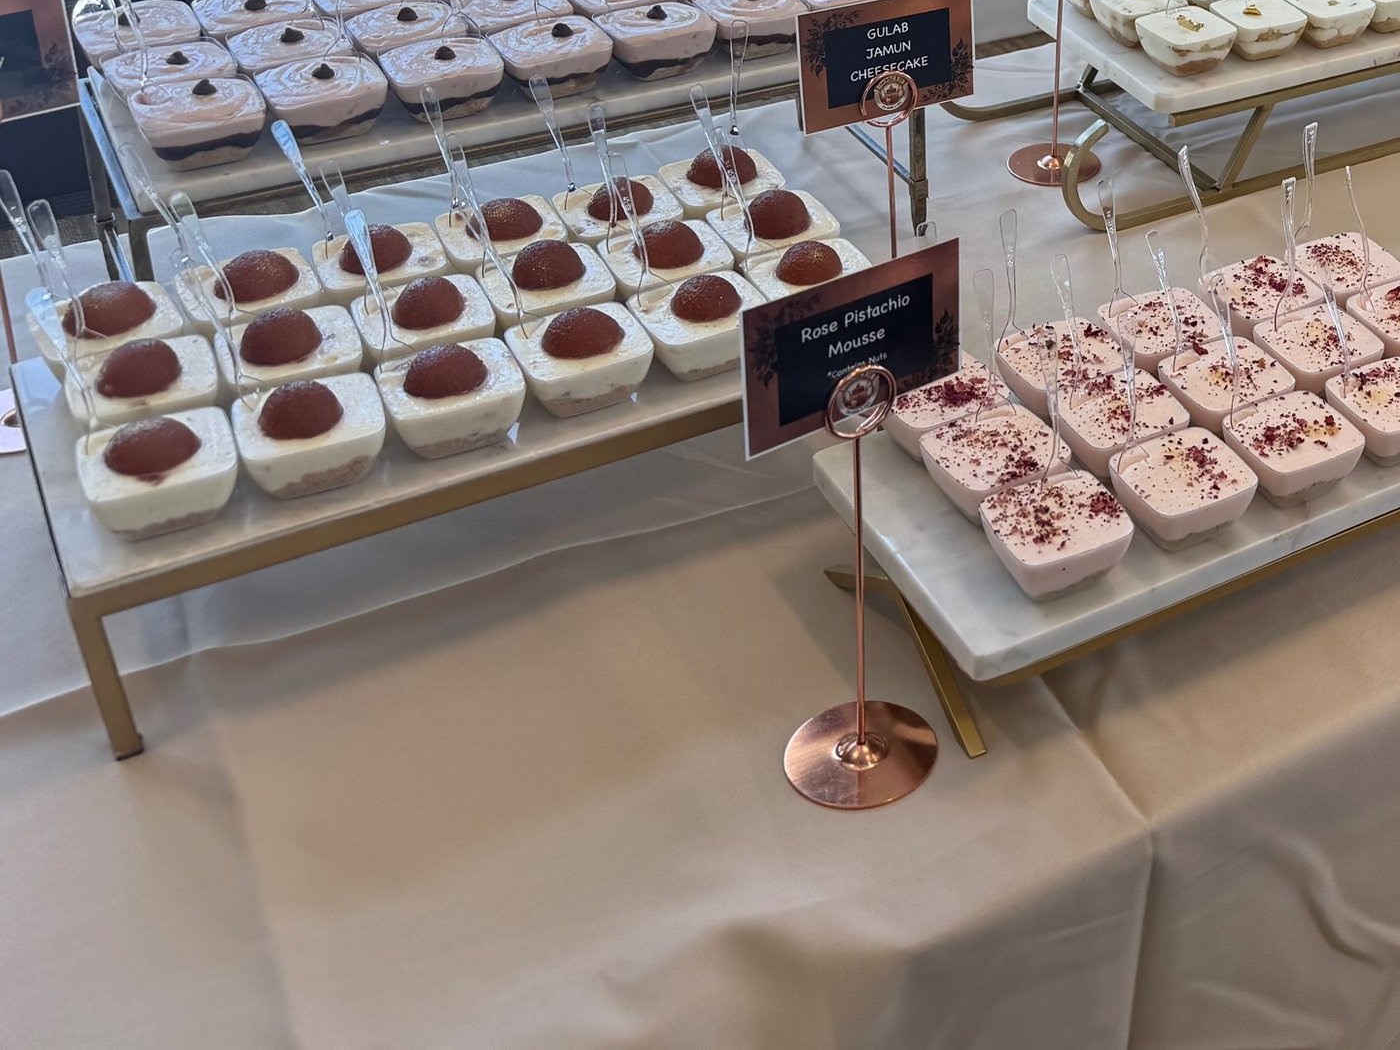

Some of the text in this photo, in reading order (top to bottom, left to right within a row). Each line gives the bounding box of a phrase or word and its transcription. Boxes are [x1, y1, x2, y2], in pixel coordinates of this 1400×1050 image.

[867, 21, 909, 40] GULAB
[866, 40, 912, 60] JAMUN
[850, 55, 929, 82] CHEESECAKE
[801, 293, 911, 344] Rose Pistachio
[827, 327, 886, 359] Mousse
[868, 352, 888, 364] Nuts
